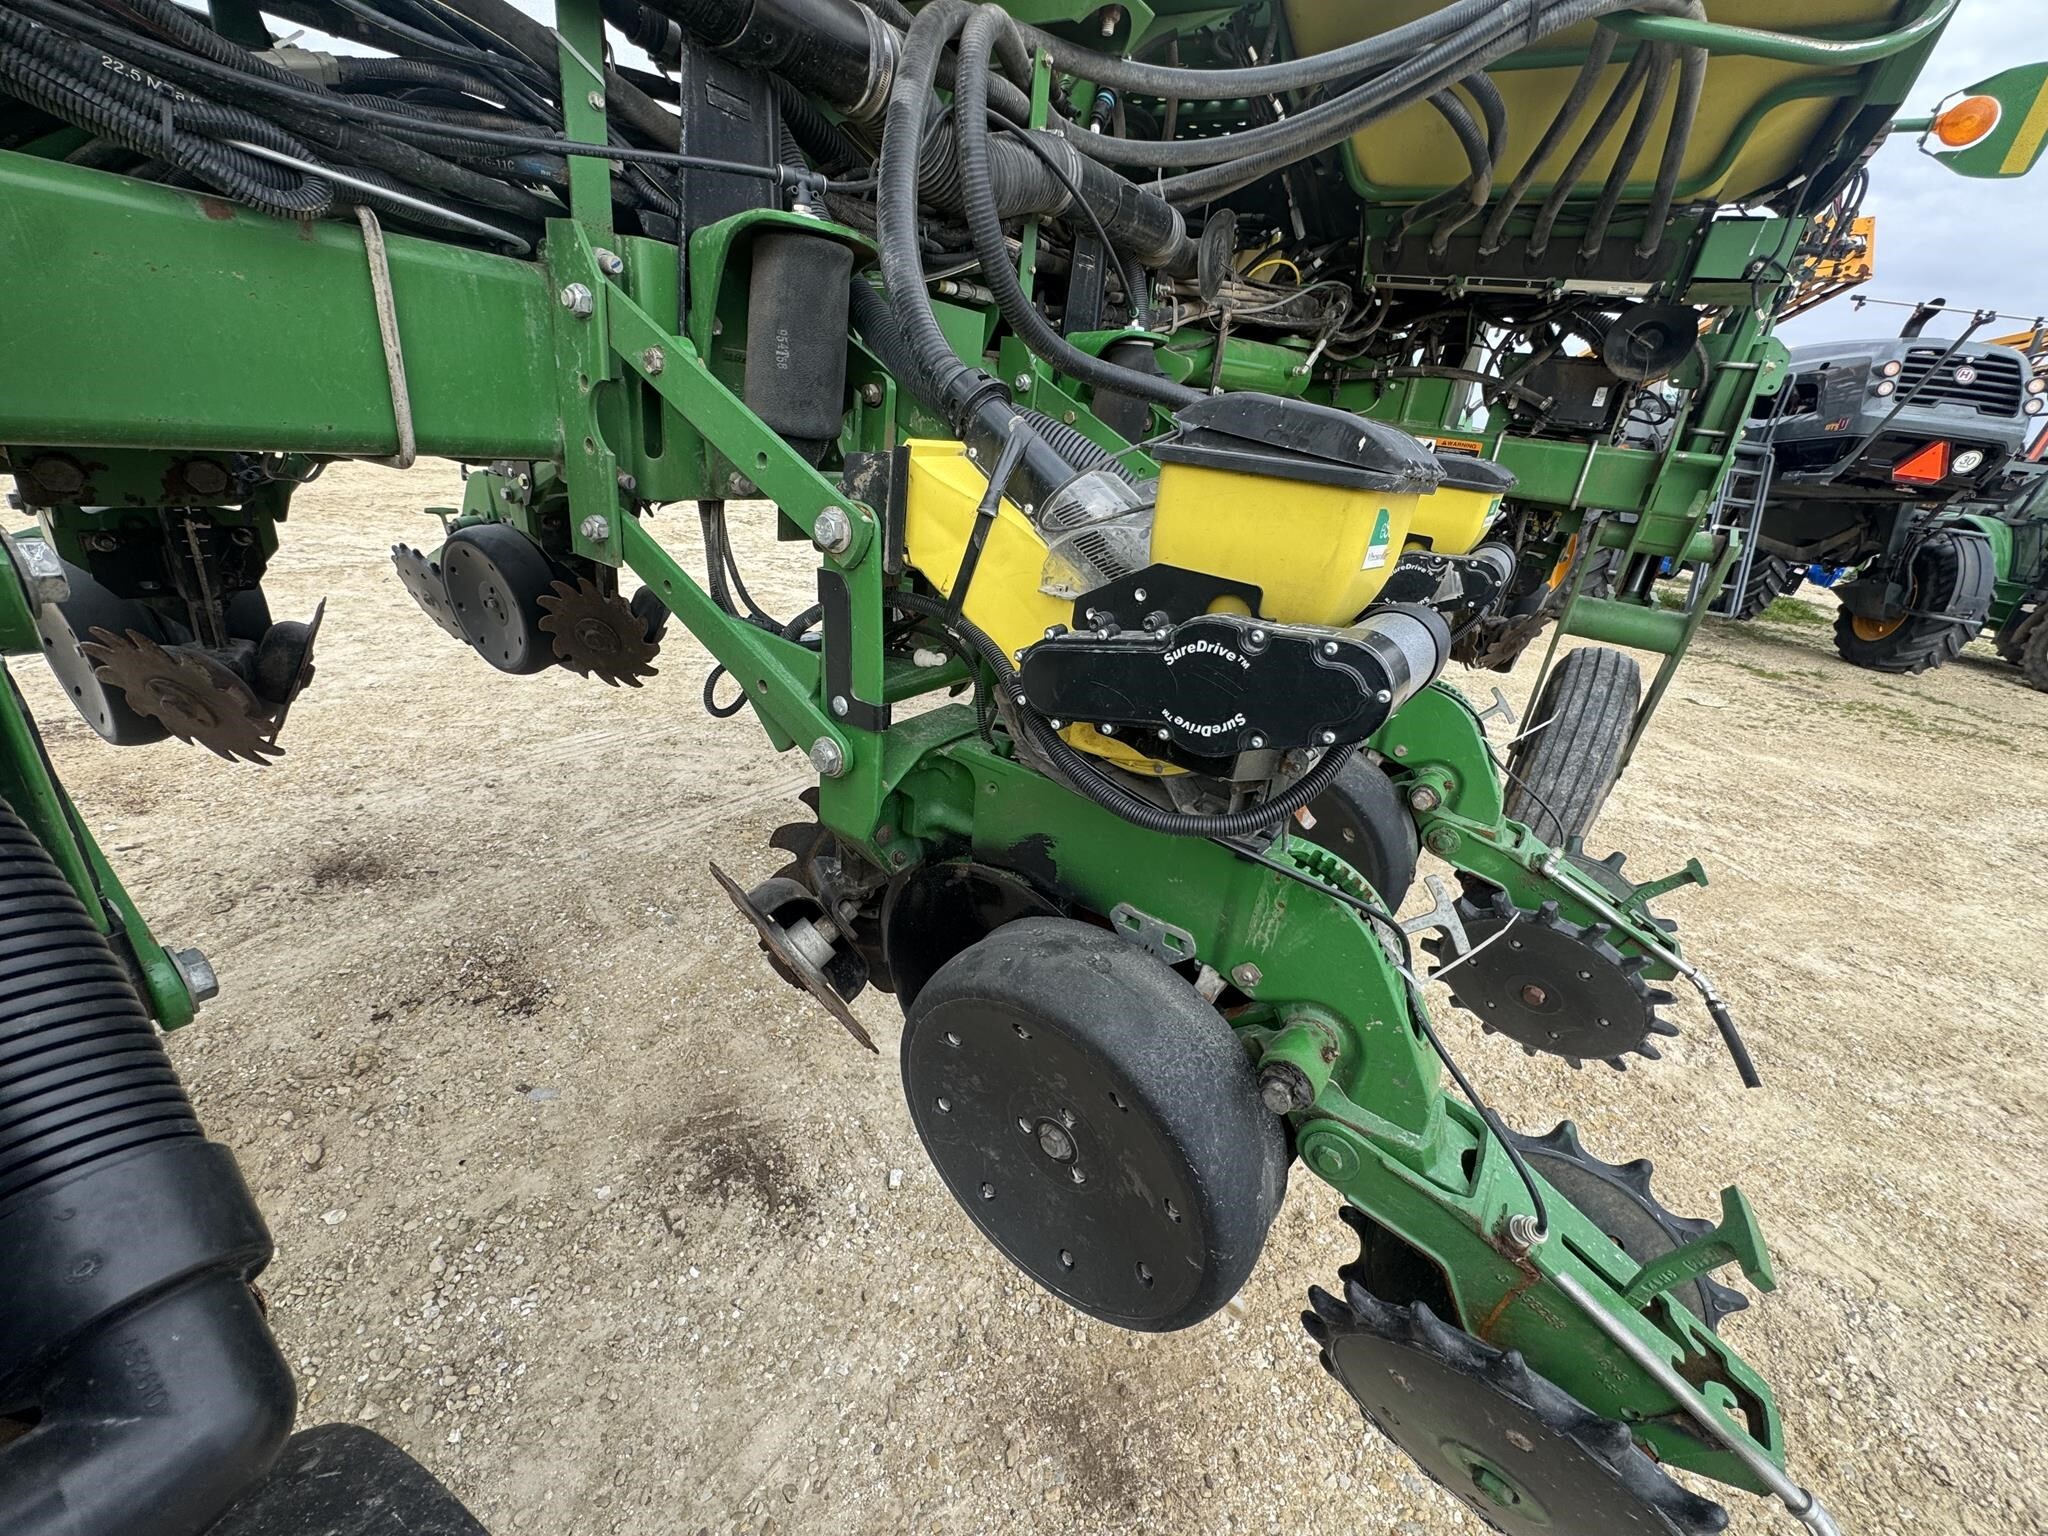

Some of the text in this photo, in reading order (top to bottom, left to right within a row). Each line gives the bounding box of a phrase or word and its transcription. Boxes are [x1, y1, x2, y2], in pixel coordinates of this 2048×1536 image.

[102, 55, 141, 82] 22.5
[1448, 441, 1477, 449] WARNING
[1959, 455, 1977, 466] 30
